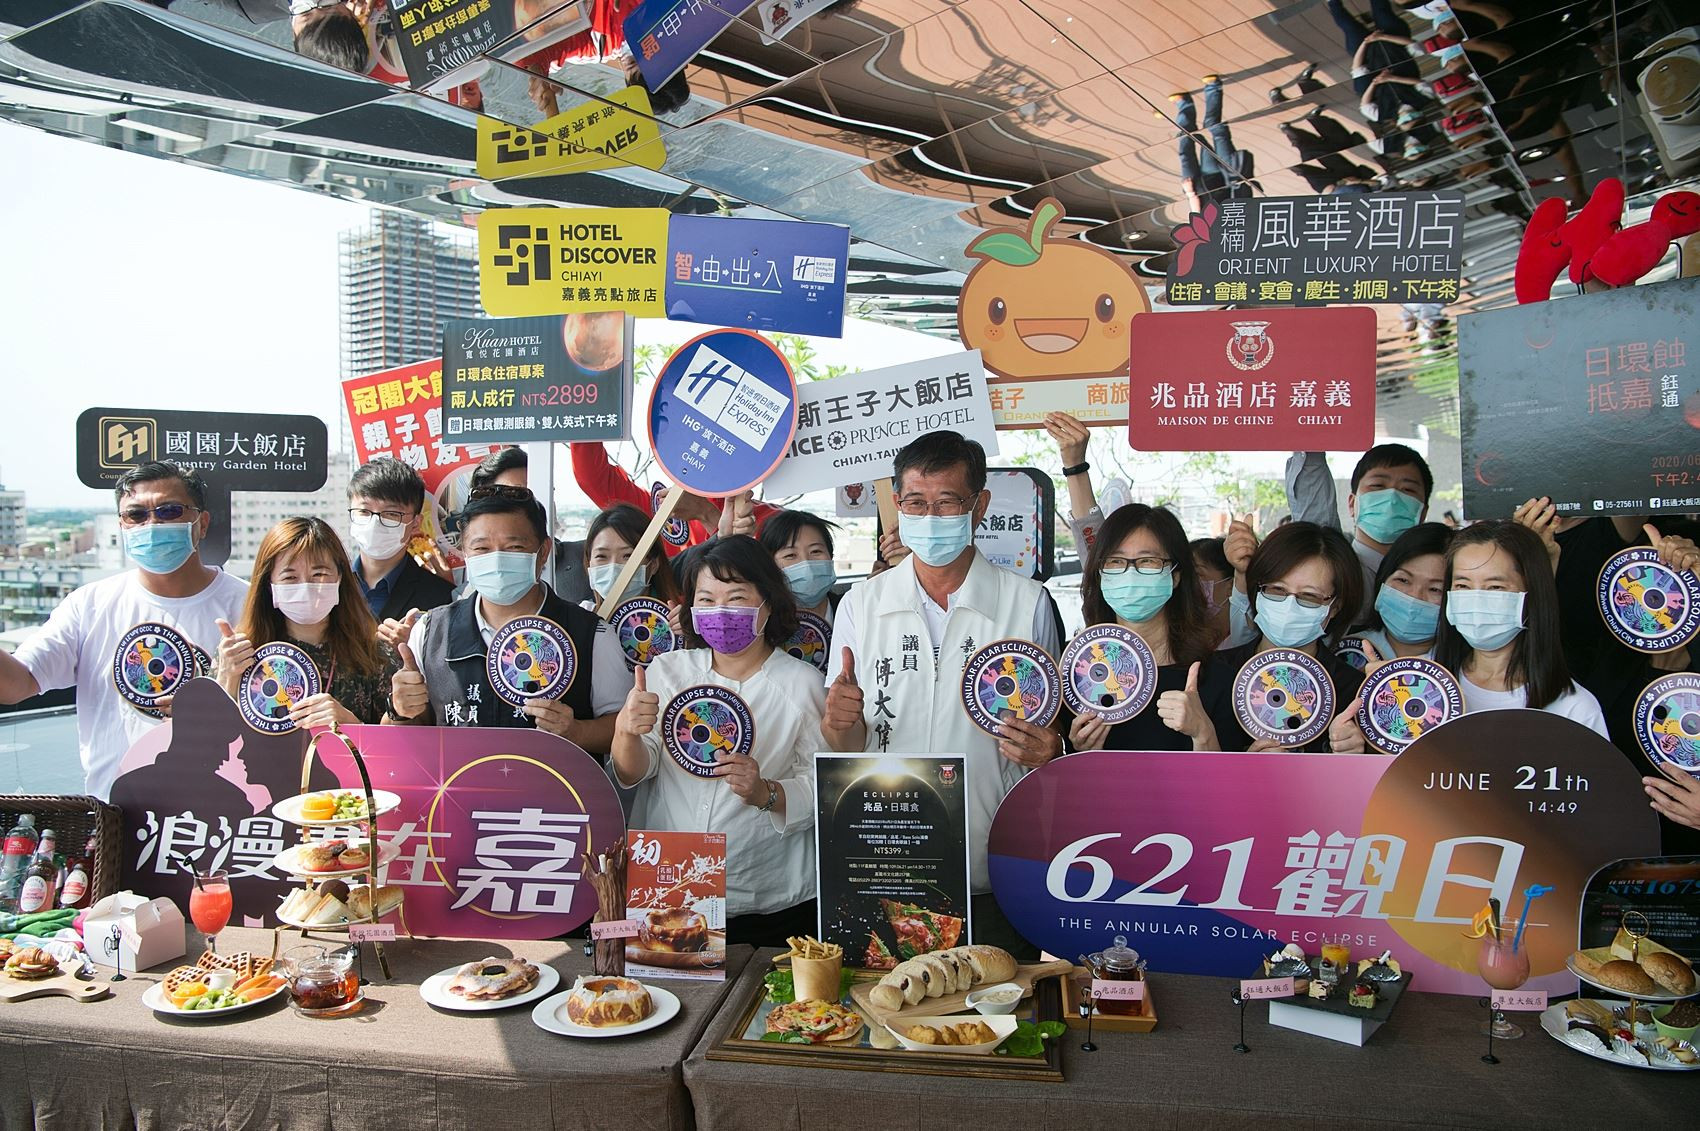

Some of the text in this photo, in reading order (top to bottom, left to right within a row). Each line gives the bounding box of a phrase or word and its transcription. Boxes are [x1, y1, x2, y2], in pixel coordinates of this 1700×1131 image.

[560, 224, 622, 241] HOTEL
[1220, 202, 1246, 254] 嘉楠
[1252, 194, 1462, 252] 風華酒店
[560, 247, 657, 264] DISCOVER
[1218, 254, 1458, 275] ORIENT LUXURY HOTEL
[562, 271, 602, 282] CHIAYI
[562, 288, 657, 302] 嘉義亮點旅店
[462, 328, 542, 350] Kuan HOTEL
[1586, 337, 1686, 378] 日環蝕
[456, 364, 544, 382] 日環食住宿專案
[451, 384, 598, 408] 兩人成行 NT$2899
[1150, 380, 1352, 409] 兆品酒店 嘉義
[1588, 378, 1652, 414] 抵嘉
[735, 394, 775, 424] Holiday Inn
[728, 404, 768, 437] Express
[1158, 416, 1342, 426] MAISON DE CHINE CHIAYI
[785, 407, 974, 459] ICE PRINCE HOTEL
[166, 430, 306, 458] 國園大飯店
[223, 460, 267, 470] Garden
[274, 461, 306, 471] Hotel
[682, 452, 706, 472] CHIAYI
[1613, 553, 1630, 567] 2020
[628, 600, 653, 609] SOLAR
[1599, 590, 1609, 616] Taiwan
[509, 619, 542, 632] ECLIPSE
[551, 627, 563, 640] City
[1604, 614, 1623, 635] Chiayi
[491, 627, 511, 652] SOLAR
[559, 637, 573, 656] Chiayi
[1131, 637, 1144, 650] City
[1618, 631, 1635, 644] City
[1646, 630, 1686, 648] ECLIPSE
[162, 628, 191, 677] THE ANNULAR
[256, 646, 285, 660] ECLIPSE
[294, 651, 306, 663] City
[901, 634, 918, 672] 議員
[1139, 648, 1153, 669] Chiayi
[1249, 652, 1285, 671] ECLIPSE
[1296, 654, 1311, 666] City
[490, 652, 506, 692] ANNULAR
[563, 657, 573, 679] Taiwan
[1045, 662, 1056, 675] City
[1061, 627, 1122, 706] ANNULAR SOLAR ECLIPSE
[1308, 663, 1326, 682] Chiayi
[1392, 660, 1410, 670] 2020
[1424, 663, 1444, 679] THE
[119, 683, 128, 694] City
[964, 642, 1039, 728] THE ANNULAR SOLAR ECLIPSE
[1050, 675, 1059, 697] Chiayi
[1142, 669, 1153, 693] Taiwan
[1236, 668, 1253, 697] SOLAR
[1653, 679, 1674, 694] THE
[240, 683, 257, 721] ANNULAR
[504, 690, 521, 703] THE
[672, 688, 704, 711] ECLIPSE
[715, 688, 730, 699] City
[727, 695, 744, 712] Chiayi
[1322, 681, 1331, 705] Taiwan
[444, 701, 465, 726] 陳
[467, 684, 482, 724] 議員
[1042, 697, 1058, 720] Taiwan
[1637, 700, 1649, 718] 2020
[254, 716, 270, 730] THE
[664, 707, 677, 735] SOLAR
[741, 710, 752, 732] Taiwan
[1107, 710, 1124, 720] 2020
[1236, 699, 1265, 737] ANNULAR
[1297, 728, 1315, 741] 2020
[1365, 727, 1377, 741] City
[666, 736, 696, 771] ANNULAR
[1424, 765, 1590, 792] JUNE 21th
[1528, 801, 1578, 815] 14:49
[630, 833, 661, 866] 初
[1058, 917, 1378, 947] THE ANNULAR SOLAR ECLIPSE
